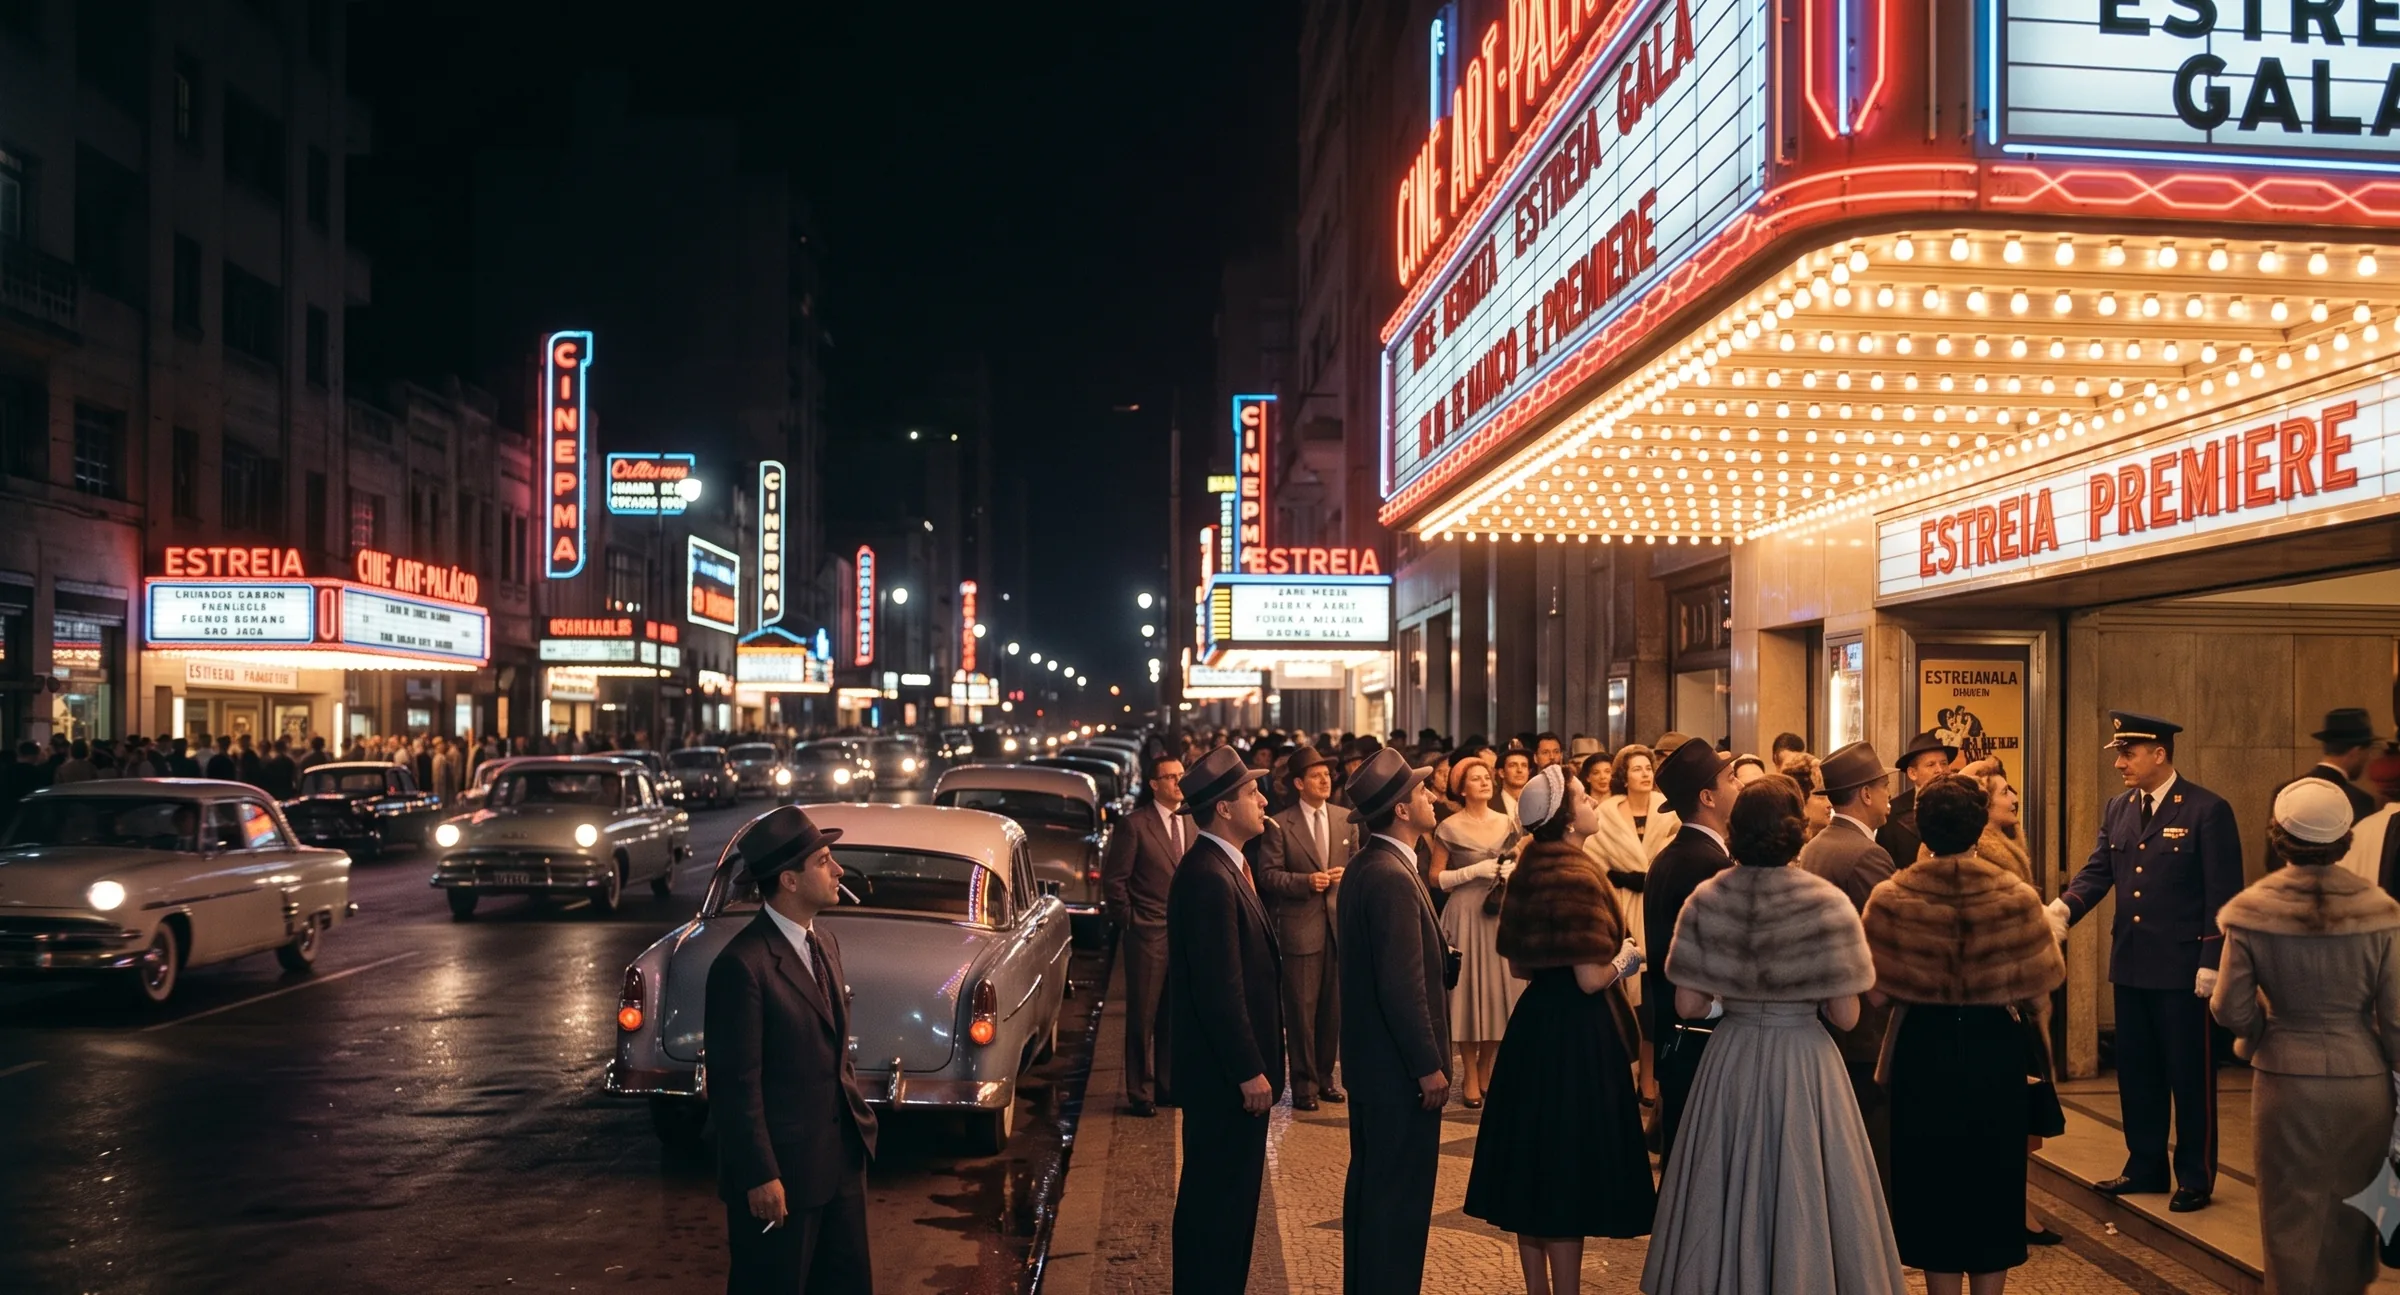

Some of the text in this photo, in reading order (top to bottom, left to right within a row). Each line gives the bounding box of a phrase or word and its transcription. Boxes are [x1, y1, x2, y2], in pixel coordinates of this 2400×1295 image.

[1397, 119, 1442, 288] CINE
[1515, 106, 1602, 259] ESTREIA
[1617, 0, 1695, 136] GALA
[1542, 187, 1657, 355] PREMIERE
[553, 342, 577, 561] CINEPMA
[1920, 399, 2359, 578] ESTREIA PREMIERE
[165, 547, 304, 577] ESTREIA
[357, 548, 392, 588] CINE
[1250, 547, 1381, 575] ESTREIA
[1925, 670, 2018, 685] ESTREIANALA
